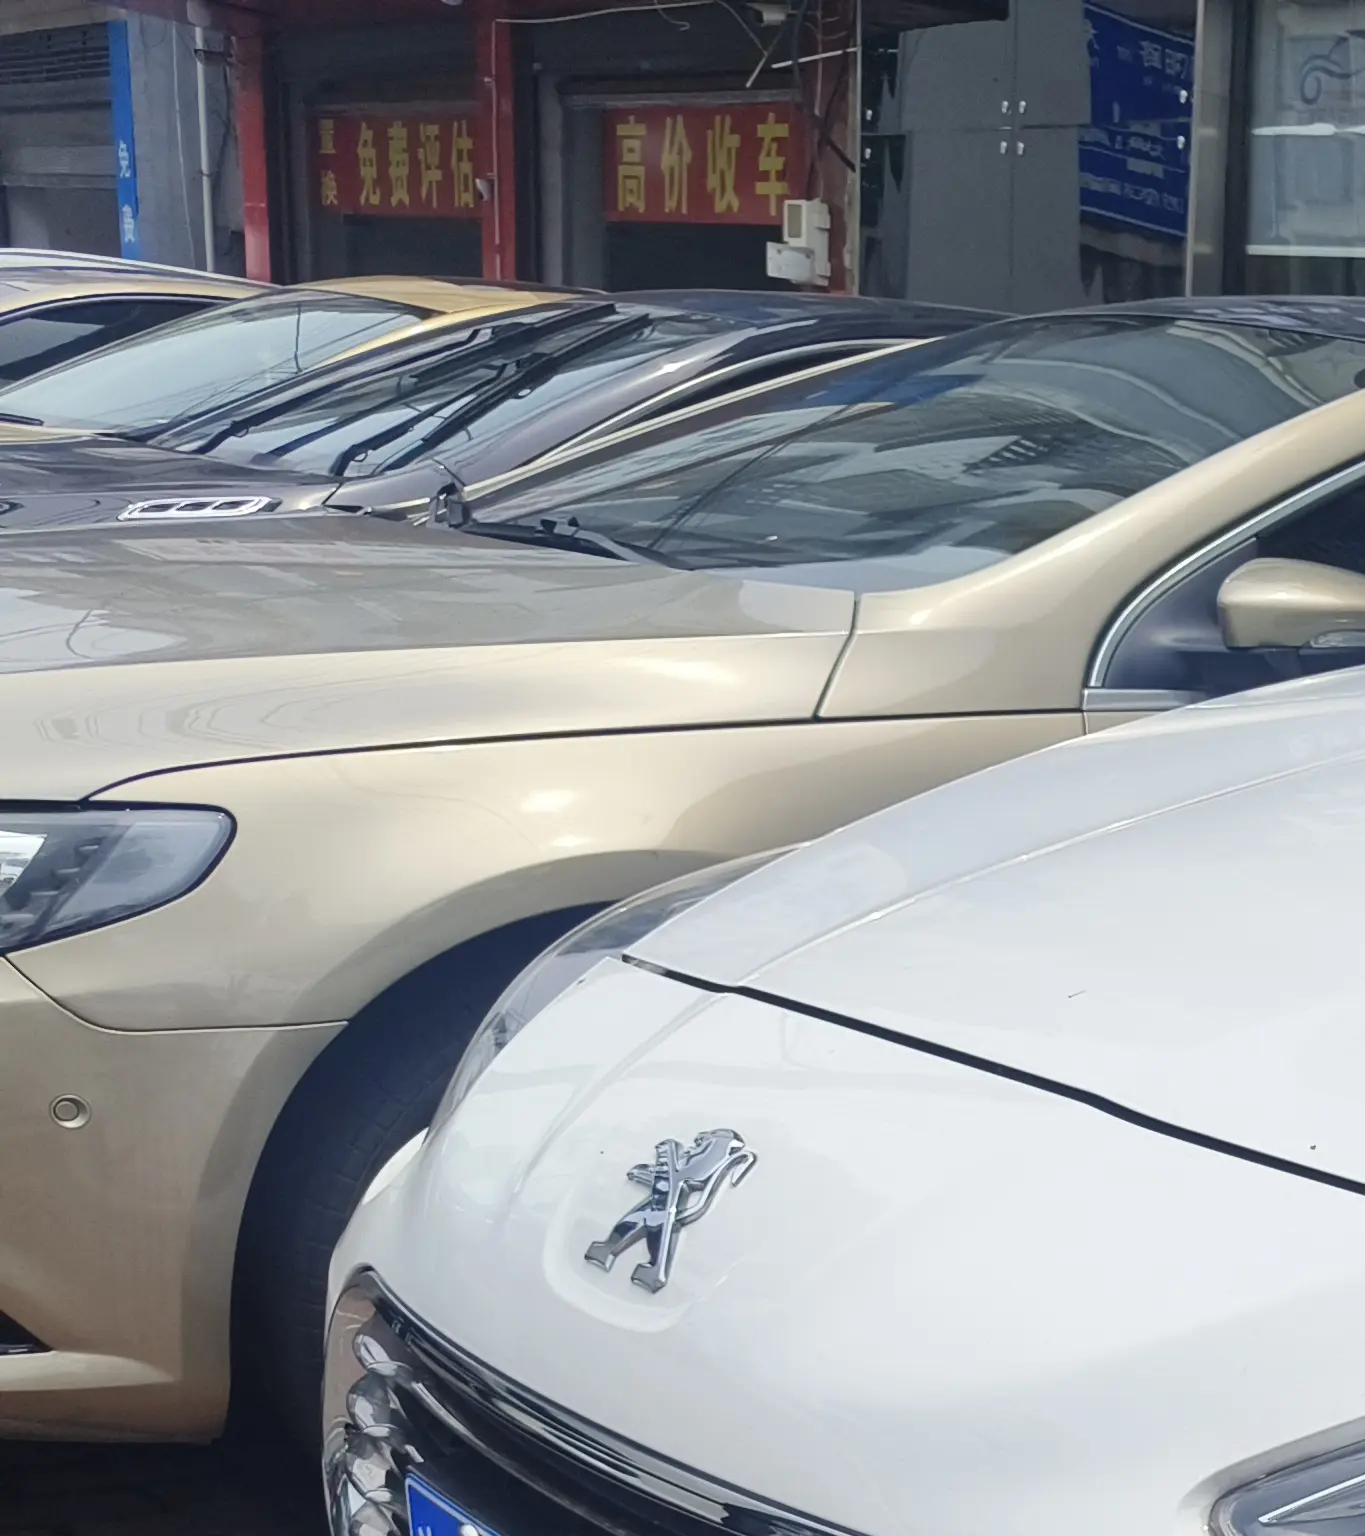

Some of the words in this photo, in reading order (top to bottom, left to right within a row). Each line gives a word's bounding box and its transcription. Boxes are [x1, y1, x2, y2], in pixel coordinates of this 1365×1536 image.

[357, 119, 475, 209] 免费评估
[616, 112, 791, 217] 高价收车
